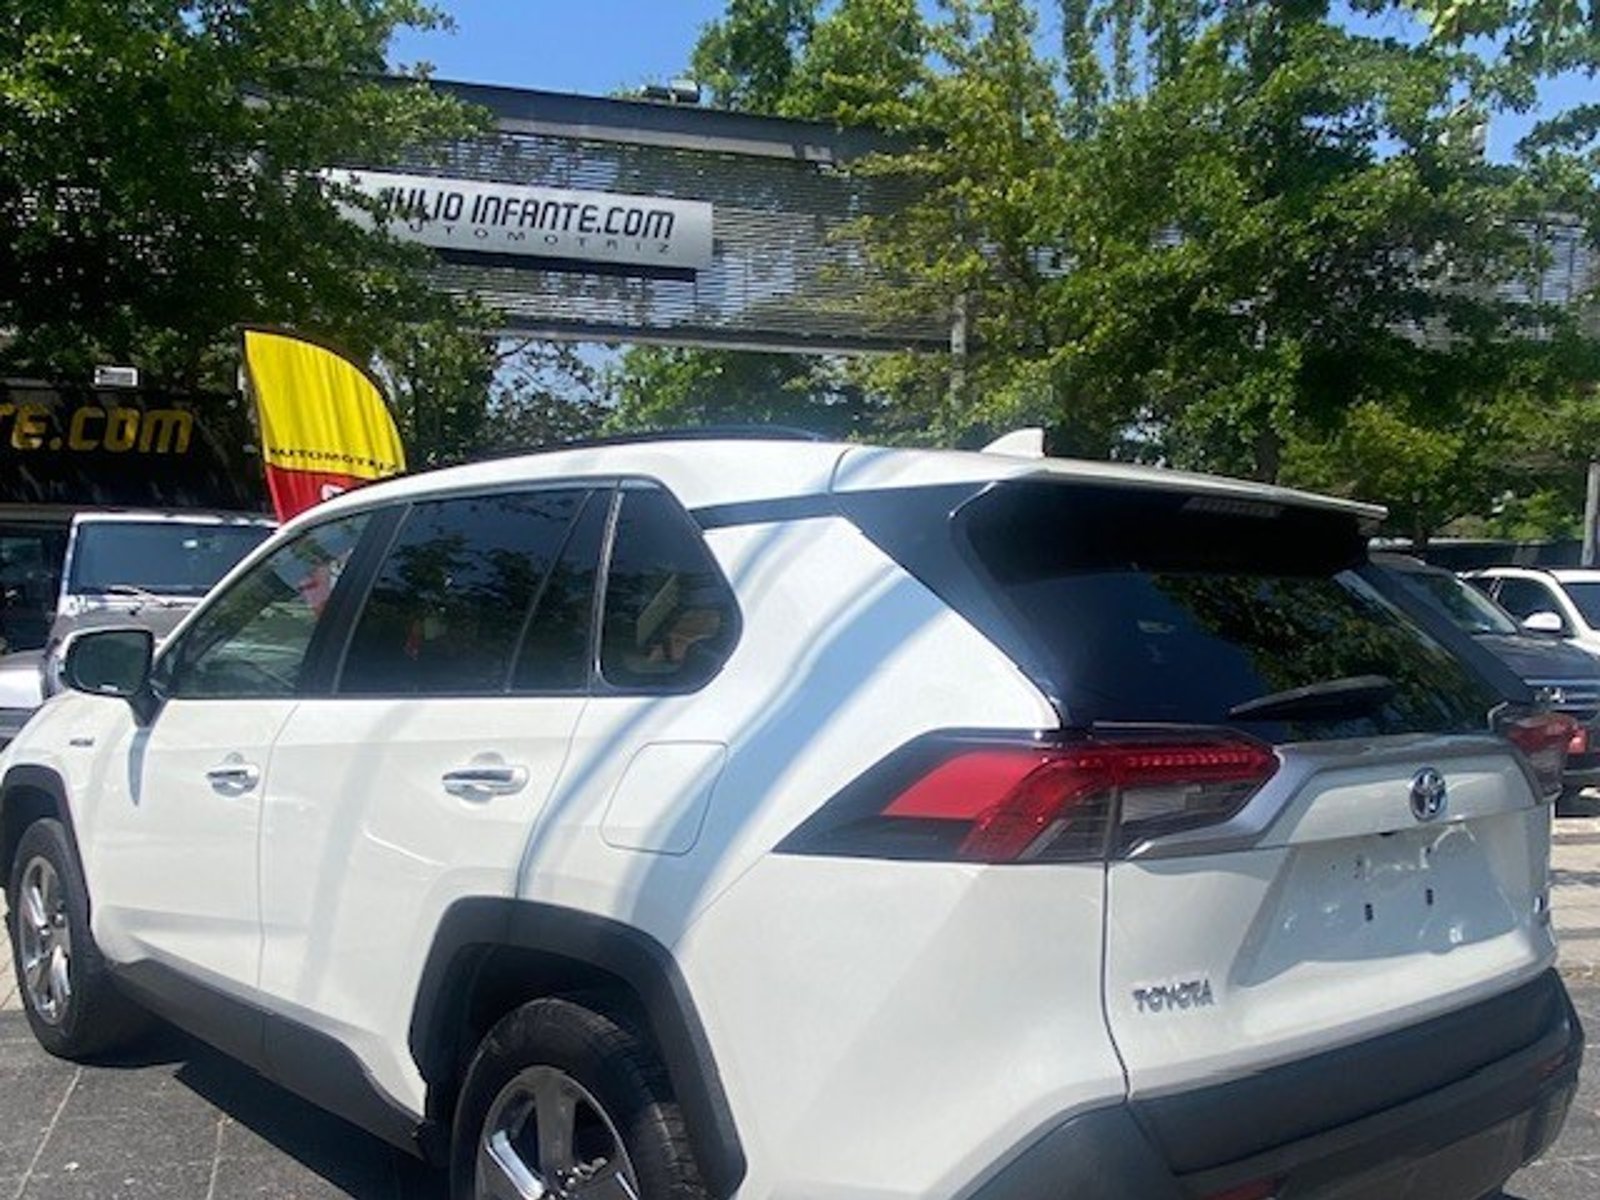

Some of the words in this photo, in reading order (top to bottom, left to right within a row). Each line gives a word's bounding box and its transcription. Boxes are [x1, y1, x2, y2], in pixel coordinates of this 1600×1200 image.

[471, 194, 675, 239] INFANTE.COM
[408, 219, 669, 253] UTOMOTRIZ
[1132, 979, 1214, 1013] TOYOTA
